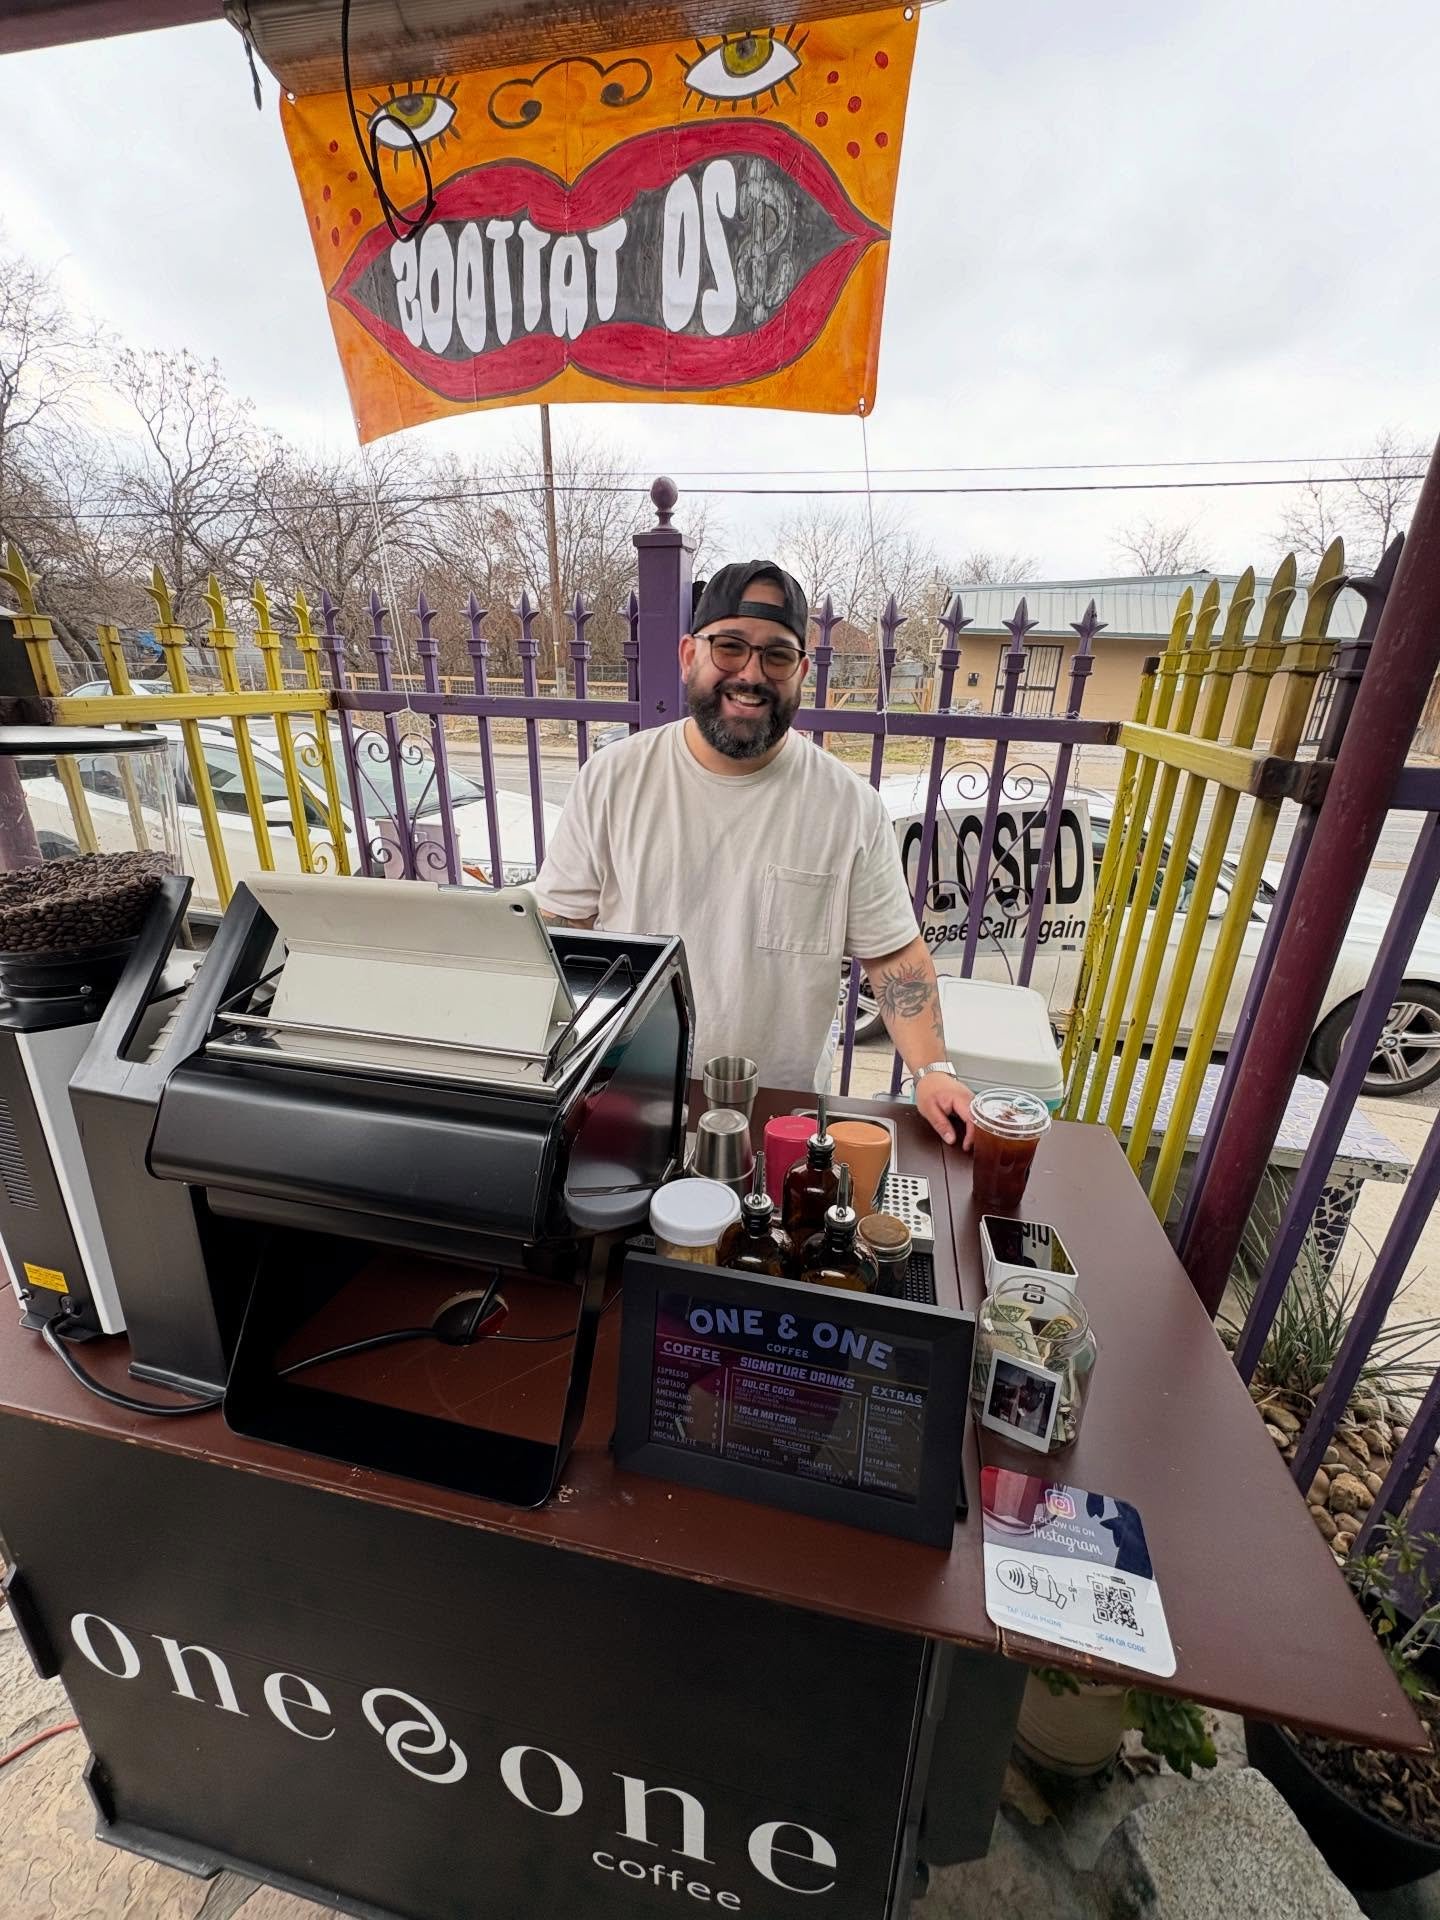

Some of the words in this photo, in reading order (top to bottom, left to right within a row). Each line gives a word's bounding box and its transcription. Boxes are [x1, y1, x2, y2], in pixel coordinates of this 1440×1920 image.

[902, 809, 1085, 911] CLOSED
[920, 920, 972, 945] lease
[977, 916, 1017, 941] Call
[1021, 914, 1086, 945] gain
[663, 1340, 721, 1362] COFFEE
[690, 1308, 764, 1336] ONE
[777, 1313, 799, 1340] &
[812, 1321, 894, 1371] ONE
[767, 1342, 809, 1360] COFFEE
[657, 1366, 689, 1379] ESPRESSO
[740, 1356, 808, 1380] SIGNATURE
[809, 1369, 857, 1391] DRINKS
[741, 1378, 771, 1392] DULCE
[771, 1384, 796, 1398] COCO
[872, 1385, 923, 1405] EXTRAS
[738, 1405, 760, 1418] ISLA
[760, 1409, 797, 1426] MATCHA
[1030, 1523, 1104, 1556] Instagram
[1082, 1526, 1096, 1538] ON
[70, 1613, 336, 1741] one
[500, 1745, 837, 1894] one
[592, 1851, 741, 1910] coffee
